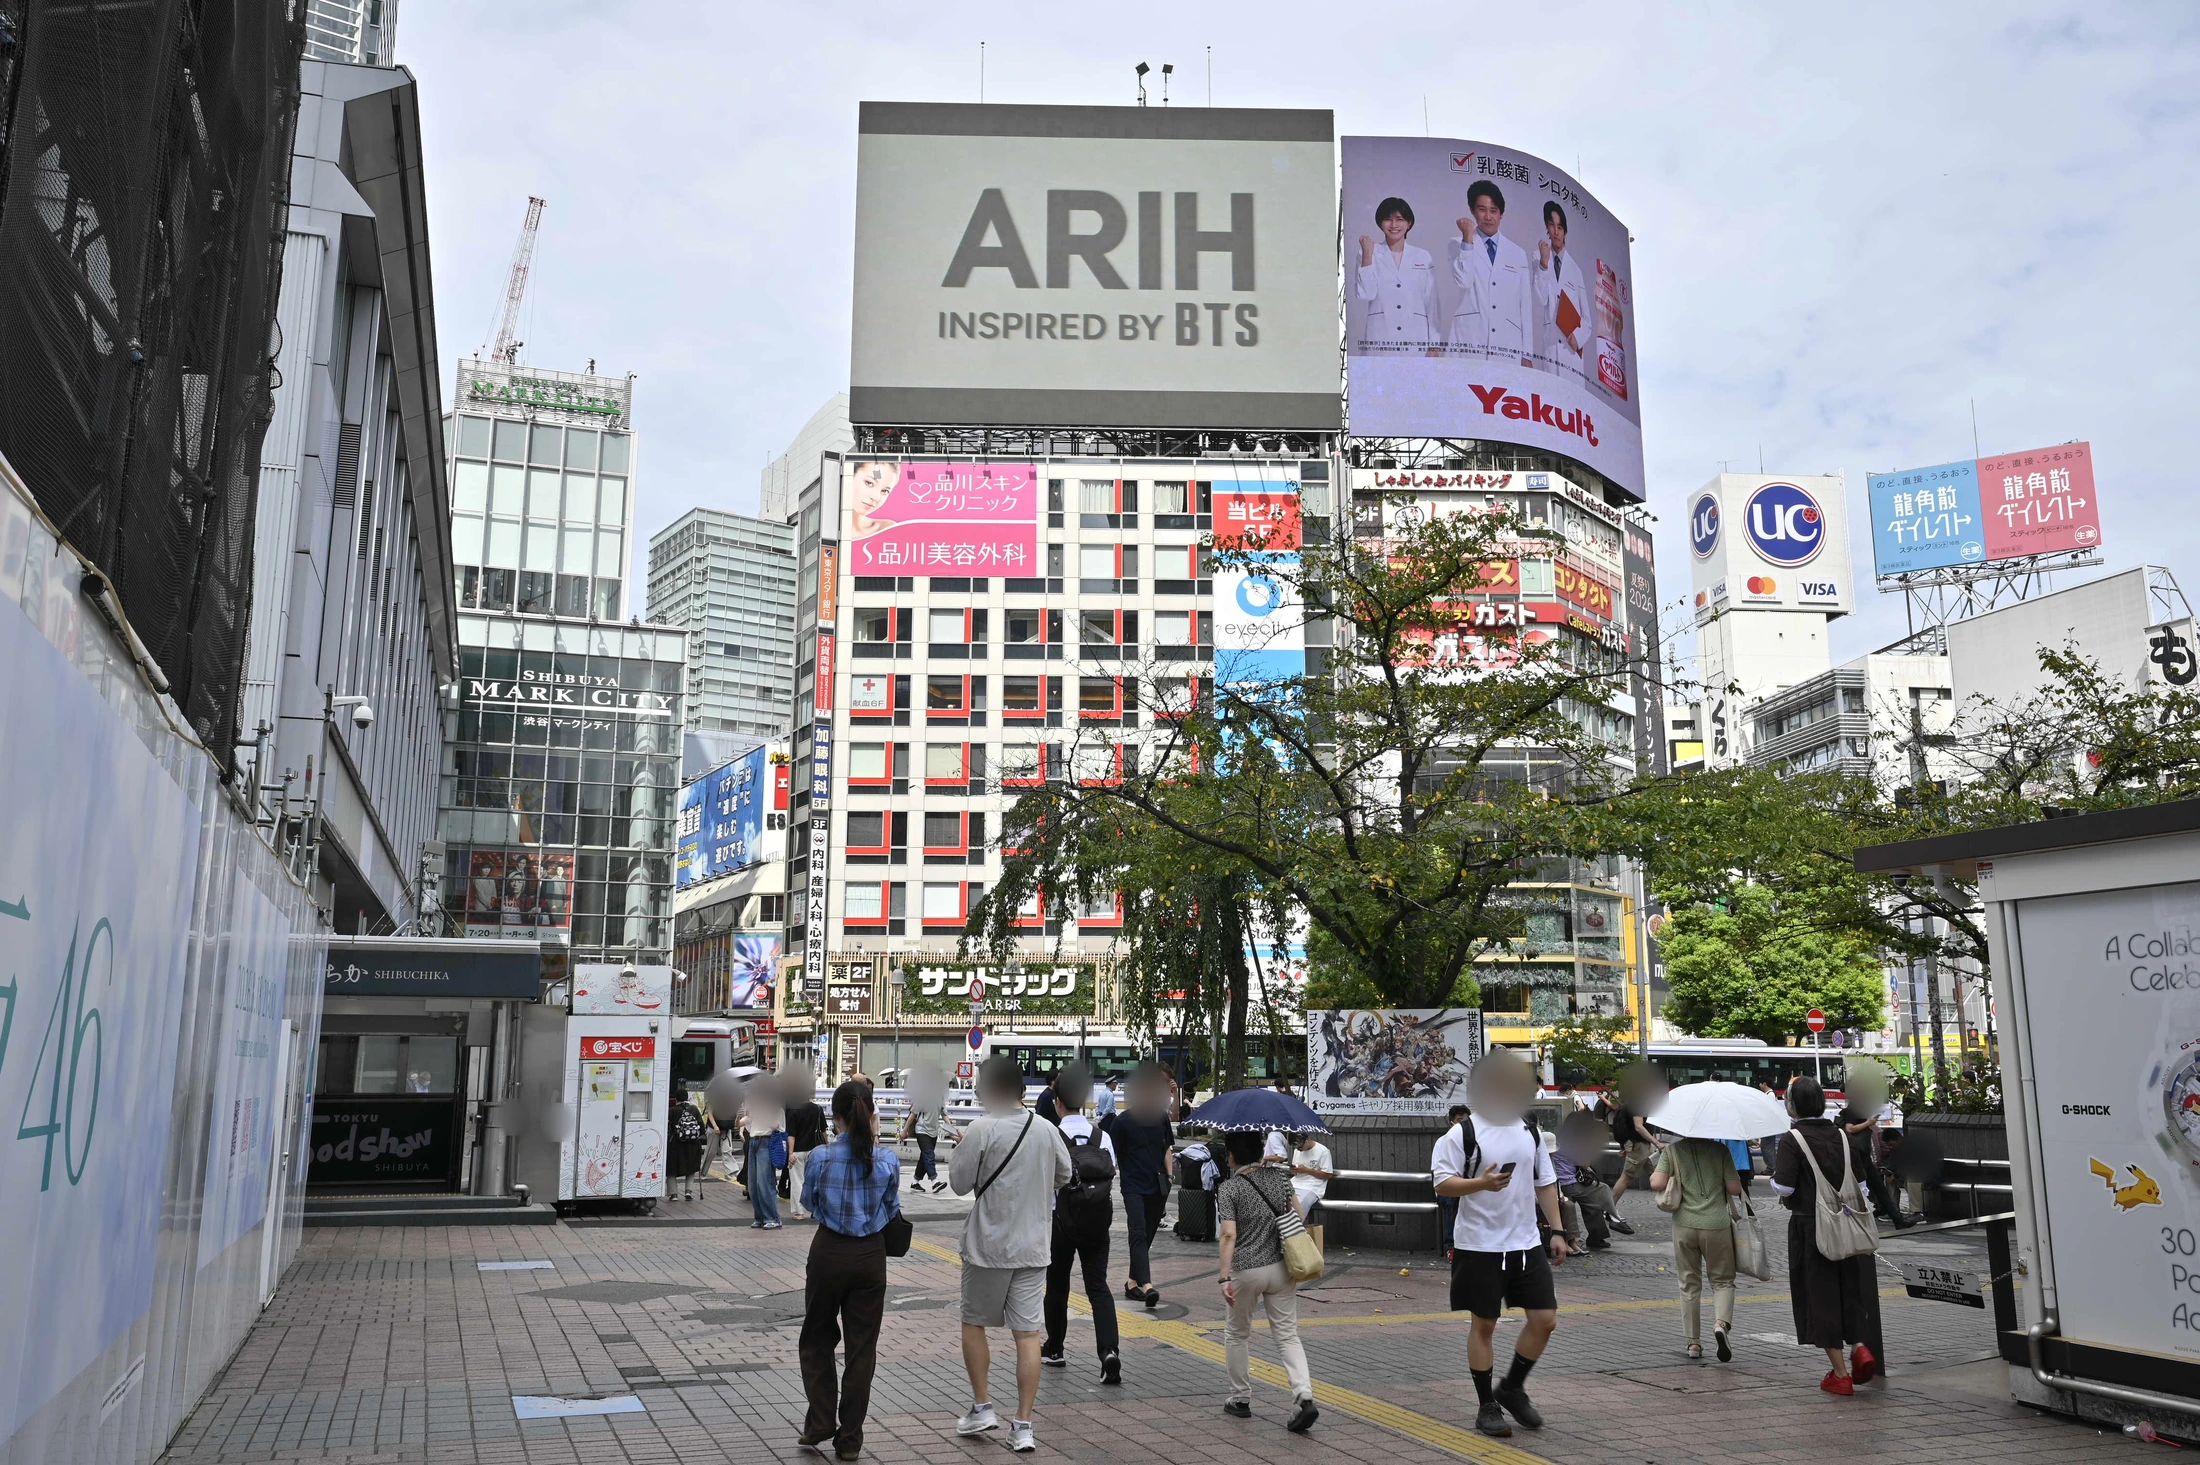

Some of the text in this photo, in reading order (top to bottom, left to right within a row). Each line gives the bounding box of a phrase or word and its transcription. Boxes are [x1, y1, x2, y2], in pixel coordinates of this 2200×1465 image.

[1477, 156, 1588, 219] 乳酸菌 シロタ株の
[941, 187, 1256, 291] ARIH
[938, 301, 1259, 347] INSPIRED BY BTS
[470, 380, 619, 409] MARK CITY
[1467, 384, 1599, 447] Yakult
[1985, 449, 2084, 472] のど、直接、うるおう
[934, 474, 1028, 492] 品川スキン
[1374, 471, 1512, 488] しゃぶしゃぶバイキング
[1528, 476, 1547, 486] 寿司
[1876, 467, 1970, 489] のど、直接、うるおう
[2003, 467, 2071, 501] 龍角散
[935, 494, 1018, 512] クリニック
[1228, 501, 1287, 521] 当ビル
[1893, 485, 1957, 518] 龍角散
[1997, 495, 2086, 528] ダイレクト
[1693, 505, 1718, 543] UC
[1752, 503, 1818, 542] UC
[1887, 511, 1972, 544] ダイレクト
[2010, 527, 2044, 538] スティック
[2076, 530, 2097, 540] 生薬
[878, 541, 1028, 567] 品川美容外科
[1899, 542, 1932, 554] スティック
[1962, 546, 1981, 556] 生薬
[823, 559, 832, 619] 東京スター銀行
[1554, 566, 1609, 611] コンタクト
[1630, 571, 1650, 593] 夏祭り
[1712, 582, 1726, 598] VISA
[1800, 582, 1837, 596] VISA
[1630, 587, 1654, 614] 2026
[1475, 603, 1536, 627] ガスト
[1225, 621, 1292, 640] eyecity
[1601, 624, 1627, 653] ガスト
[819, 636, 831, 676] 外貨両替
[523, 670, 619, 687] SHIBUYA
[470, 680, 674, 710] MARK CITY
[852, 699, 885, 708] 献血6F
[523, 716, 611, 731] 渋谷 マークシティ
[813, 727, 829, 795] 加藤眼科
[813, 799, 827, 808] 5F
[716, 819, 737, 840] 楽しむ
[812, 819, 826, 829] 3F
[715, 840, 747, 864] 遊びです。
[808, 848, 825, 974] 内科 産婦人科・心療内科
[2106, 935, 2121, 961] A
[374, 969, 450, 981] SHIBUCHIKA
[831, 964, 847, 980] 薬
[852, 966, 871, 979] 2F
[918, 966, 1079, 996] サンドラッグ
[829, 987, 870, 998] 処方せん
[839, 1000, 860, 1011] 受付
[16, 910, 113, 1192] 46
[609, 1041, 643, 1053] 宝くじ
[1308, 1013, 1321, 1092] コンテンツを作る。
[1319, 1101, 1356, 1110] Cygames
[1358, 1100, 1445, 1112] キャリア採用募集中
[2062, 1104, 2111, 1116] G-SHOCK
[333, 1114, 379, 1123] TOKYU
[359, 1127, 433, 1161] show
[375, 1163, 430, 1172] SHIBUYA
[2161, 1227, 2196, 1256] 30
[1917, 1268, 1965, 1286] 立入禁止
[1946, 1291, 1963, 1299] ENTER
